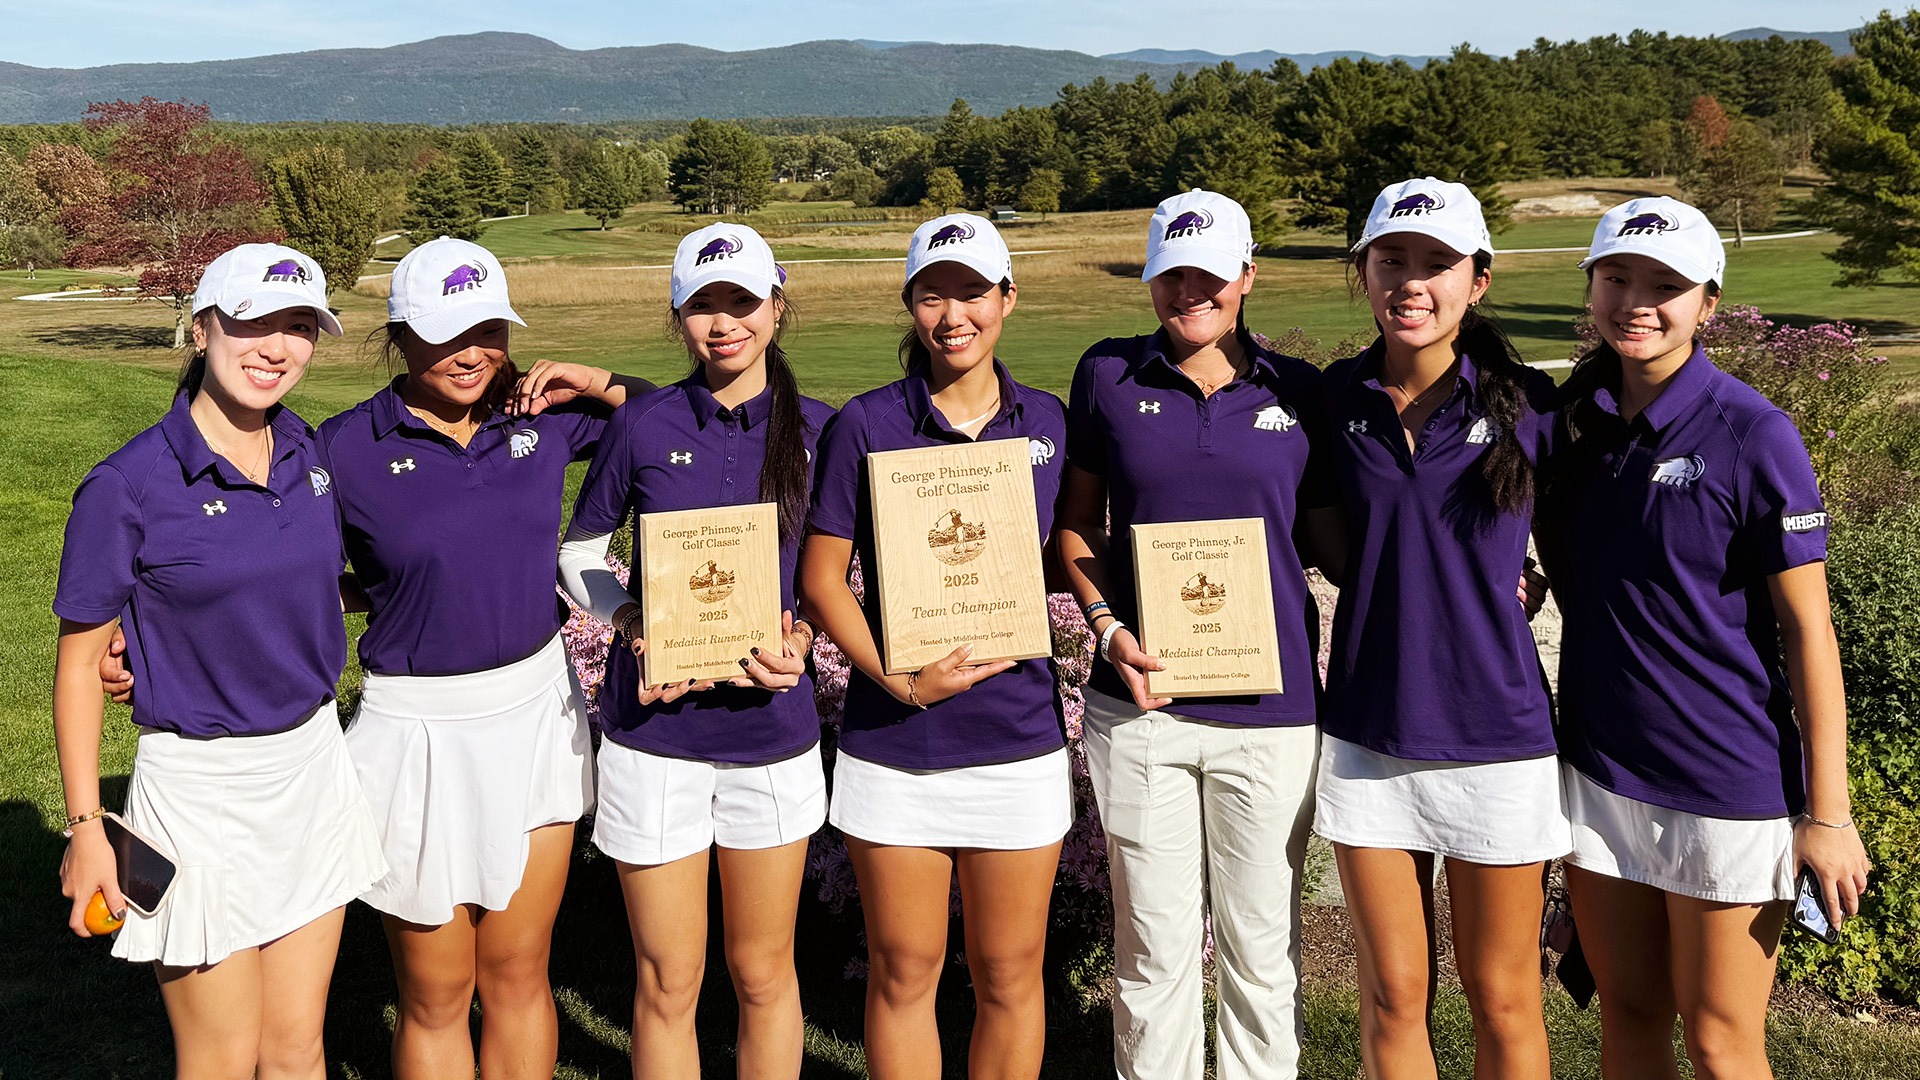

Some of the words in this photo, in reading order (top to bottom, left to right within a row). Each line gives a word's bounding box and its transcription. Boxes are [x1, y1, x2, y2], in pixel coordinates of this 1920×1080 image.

[891, 470, 936, 484] George
[939, 465, 993, 479] Phinney,
[995, 461, 1012, 474] Jr.
[917, 485, 944, 498] Golf
[946, 481, 990, 495] Classic
[662, 528, 698, 539] George
[701, 525, 744, 537] Phinney,
[745, 522, 758, 532] Jr.
[682, 540, 703, 550] Golf
[706, 538, 740, 548] Classic
[1152, 540, 1187, 550] George
[1189, 537, 1231, 548] Phinney,
[1233, 535, 1246, 545] Jr.
[1171, 551, 1193, 561] Golf
[1195, 550, 1229, 560] Classic
[944, 573, 979, 588] 2025
[699, 610, 728, 622] 2025
[912, 605, 947, 619] Team
[951, 598, 1017, 615] Champion
[1192, 622, 1222, 634] 2025
[663, 635, 706, 649] Medalist
[710, 630, 765, 645] Runner-Up
[920, 637, 943, 647] Hosted
[944, 637, 952, 645] by
[953, 633, 989, 644] Middlebury
[991, 631, 1014, 640] College
[1159, 647, 1204, 659] Medalist
[1207, 645, 1261, 658] Champion
[676, 662, 695, 670] Hosted
